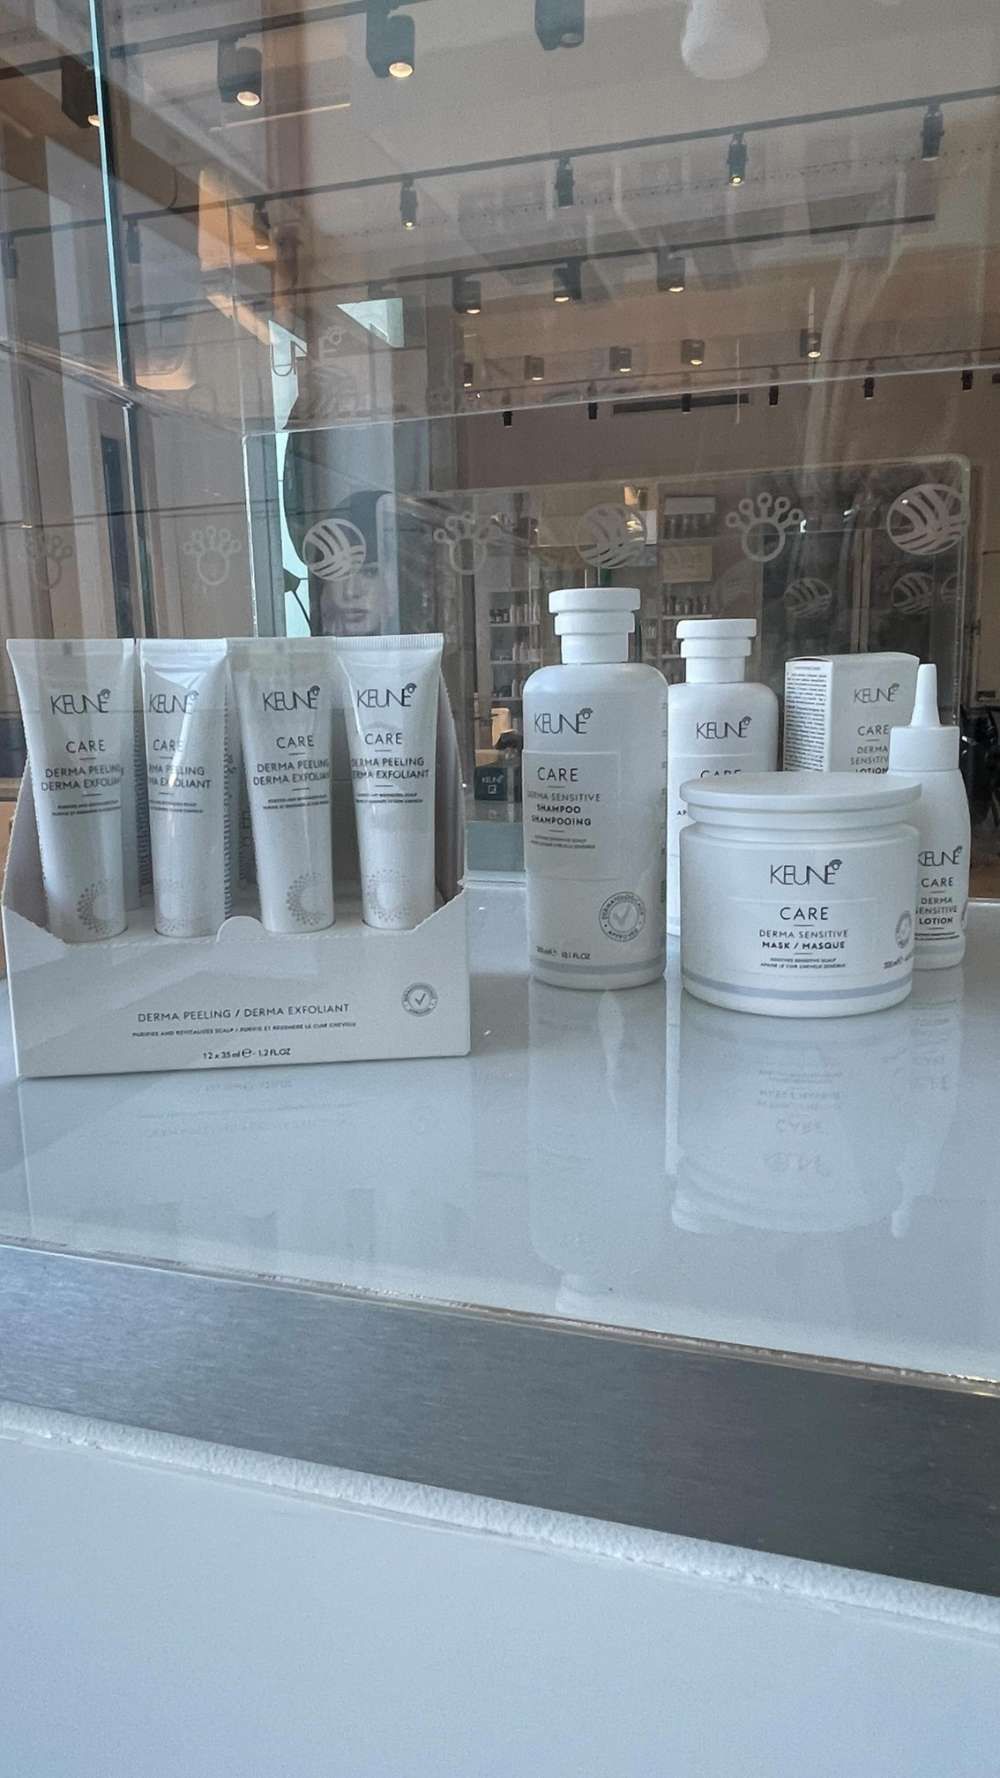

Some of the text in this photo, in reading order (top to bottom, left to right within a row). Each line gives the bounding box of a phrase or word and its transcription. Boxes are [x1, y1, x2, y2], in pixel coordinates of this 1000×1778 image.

[357, 683, 417, 709] KEUNE
[854, 683, 899, 703] KEUNE
[50, 688, 111, 715] KEUNE
[263, 686, 320, 712] KEUNE
[534, 708, 593, 734] KEUNE
[696, 716, 752, 740] KEUNE
[857, 724, 889, 736] CARE
[276, 735, 314, 749] CARE
[365, 732, 403, 745] CARE
[66, 740, 106, 753] CARE
[857, 745, 888, 754] DERMA
[382, 757, 424, 767] PEELING
[850, 756, 889, 765] SENSITIV
[45, 767, 86, 778] DERMA
[257, 762, 294, 773] DERMA
[376, 769, 429, 779] EXFOLIANT
[538, 767, 578, 782] CARE
[41, 780, 81, 791] DERMA
[253, 775, 289, 786] DERMA
[552, 792, 600, 802] SENSITIVE
[537, 803, 581, 813] SHAMPOO
[531, 815, 591, 825] SHAMPOOING
[770, 859, 842, 885] KEUNE
[921, 877, 954, 887] CARE
[780, 907, 829, 920] CARE
[919, 917, 953, 925] LOTION
[759, 929, 848, 939] DERMA SENSITIVE
[762, 941, 845, 950] MASK / MASQUE
[138, 1004, 349, 1022] DERMA PEELING / DERMA EXFOLIANT
